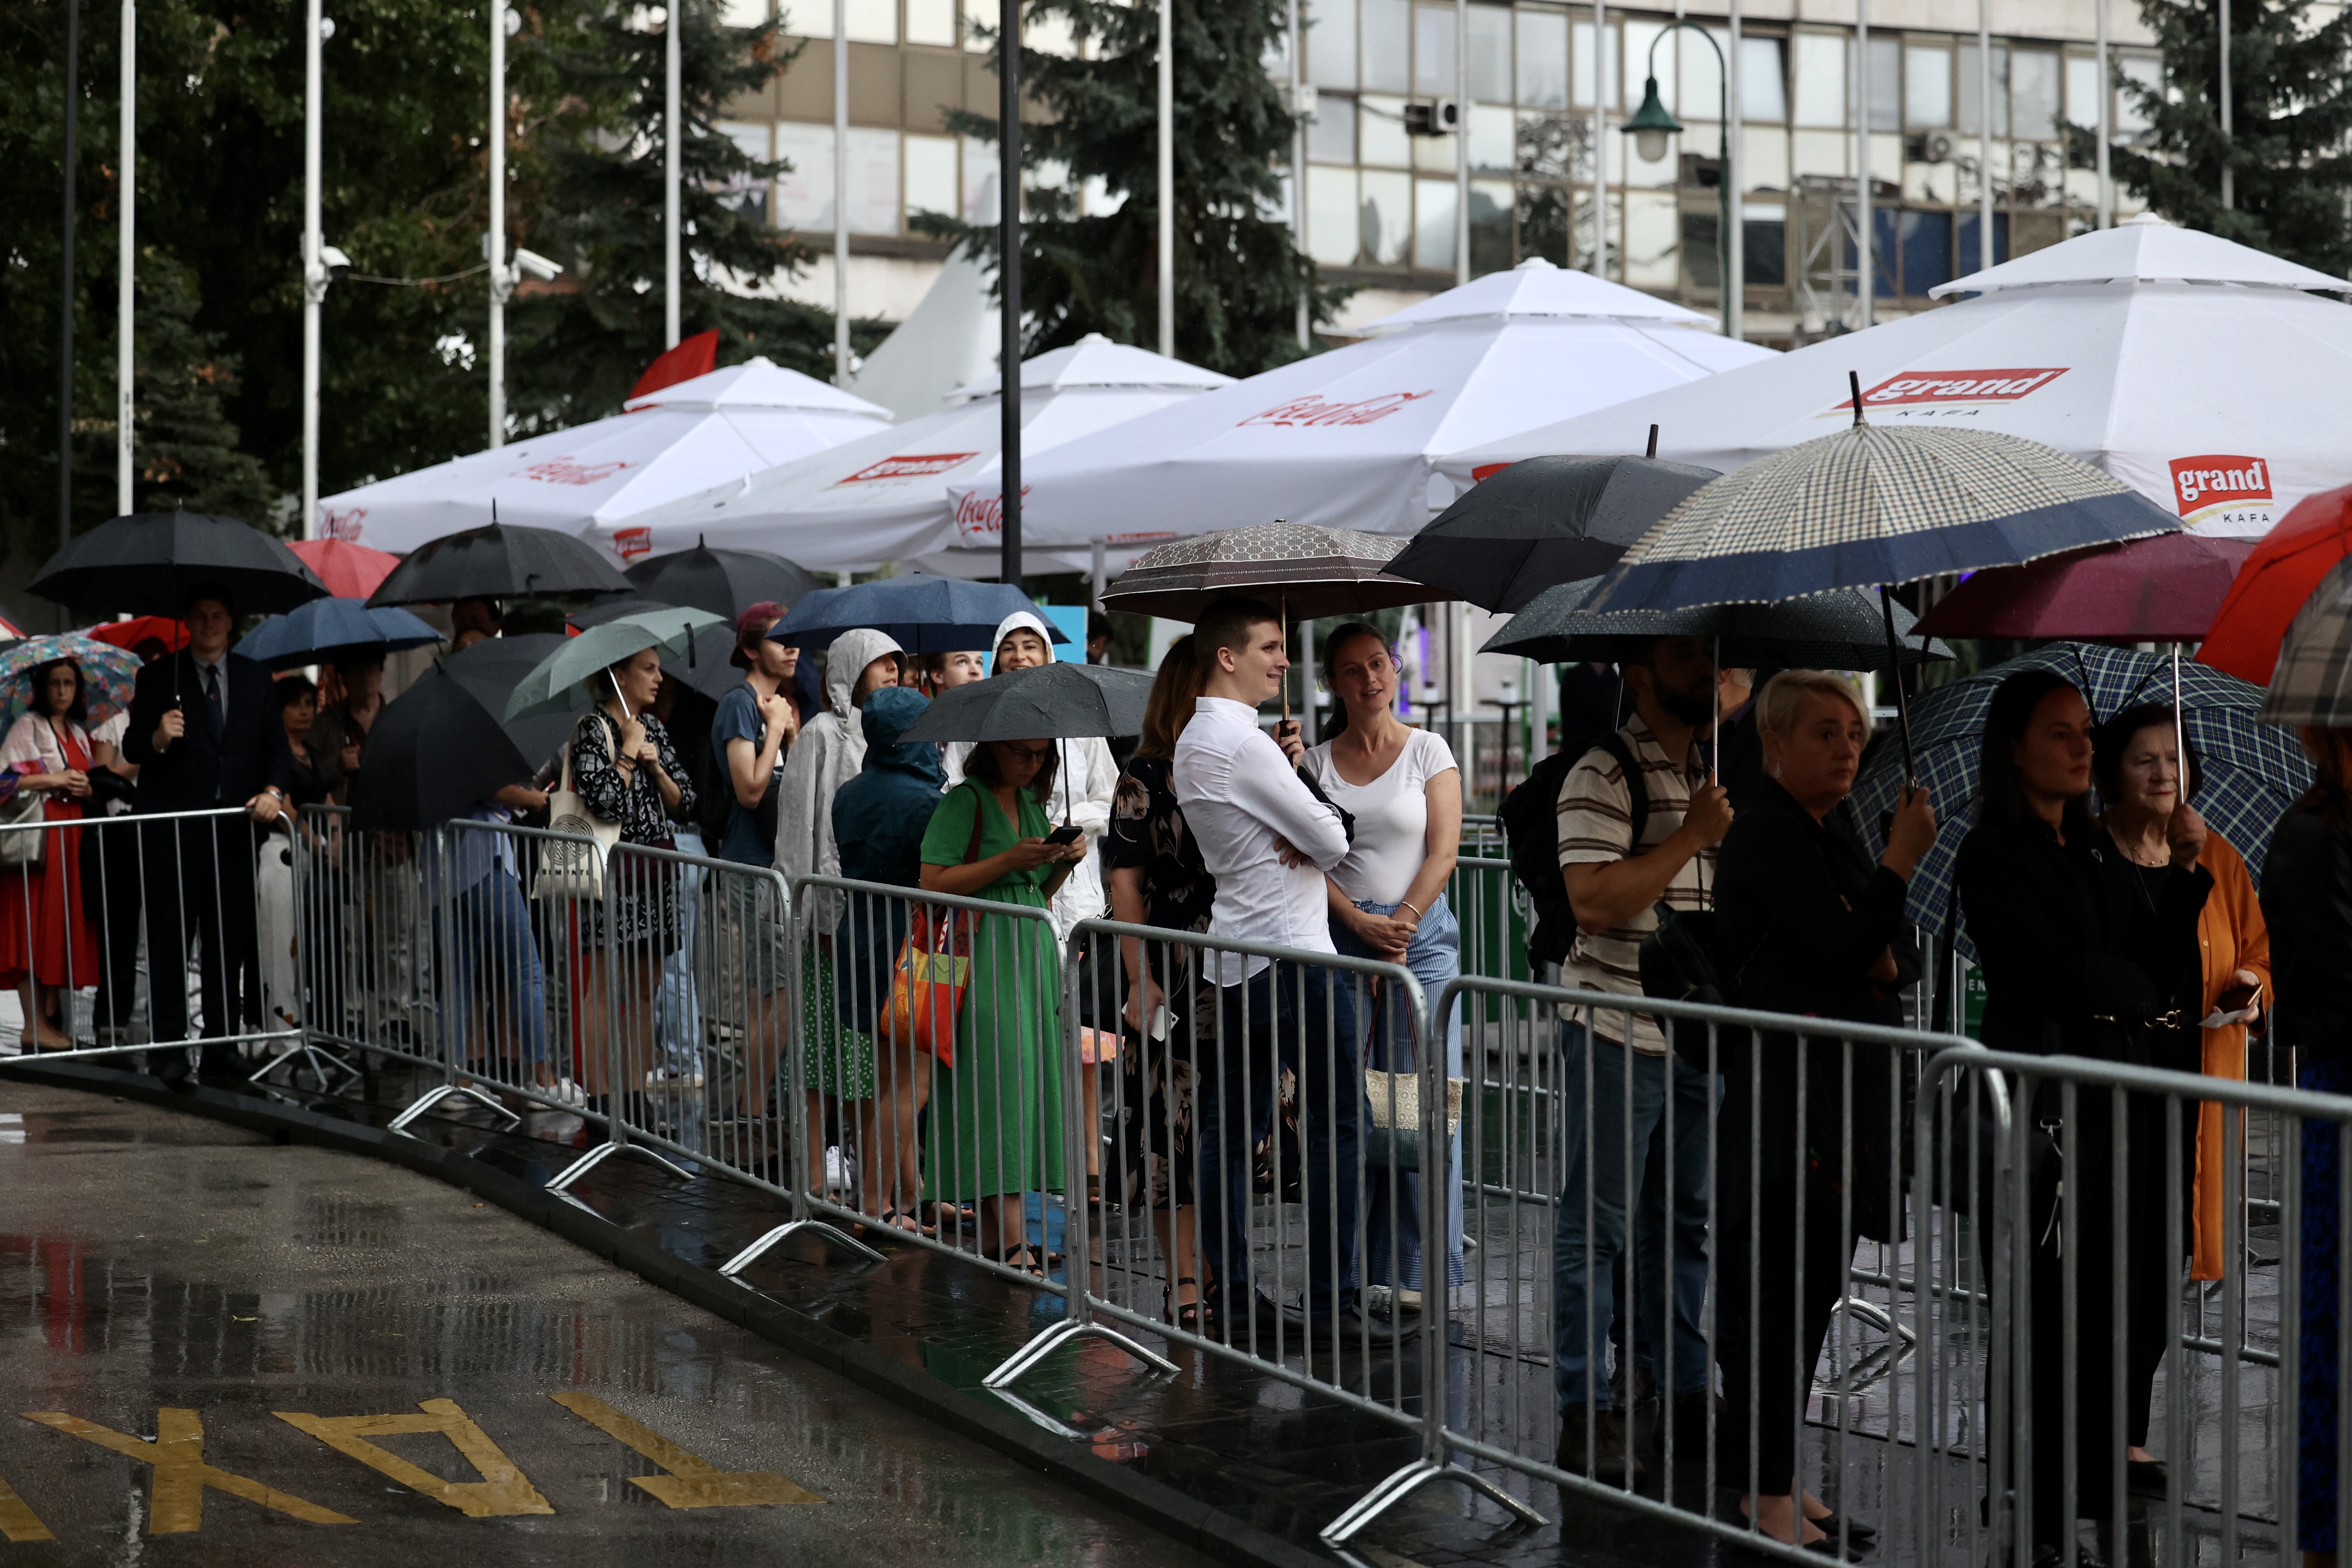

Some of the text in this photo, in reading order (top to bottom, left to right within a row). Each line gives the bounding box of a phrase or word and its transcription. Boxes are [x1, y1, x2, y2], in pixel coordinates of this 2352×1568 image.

[1865, 371, 2056, 402] grand
[2177, 461, 2266, 502] grand
[2223, 514, 2270, 523] KAFA
